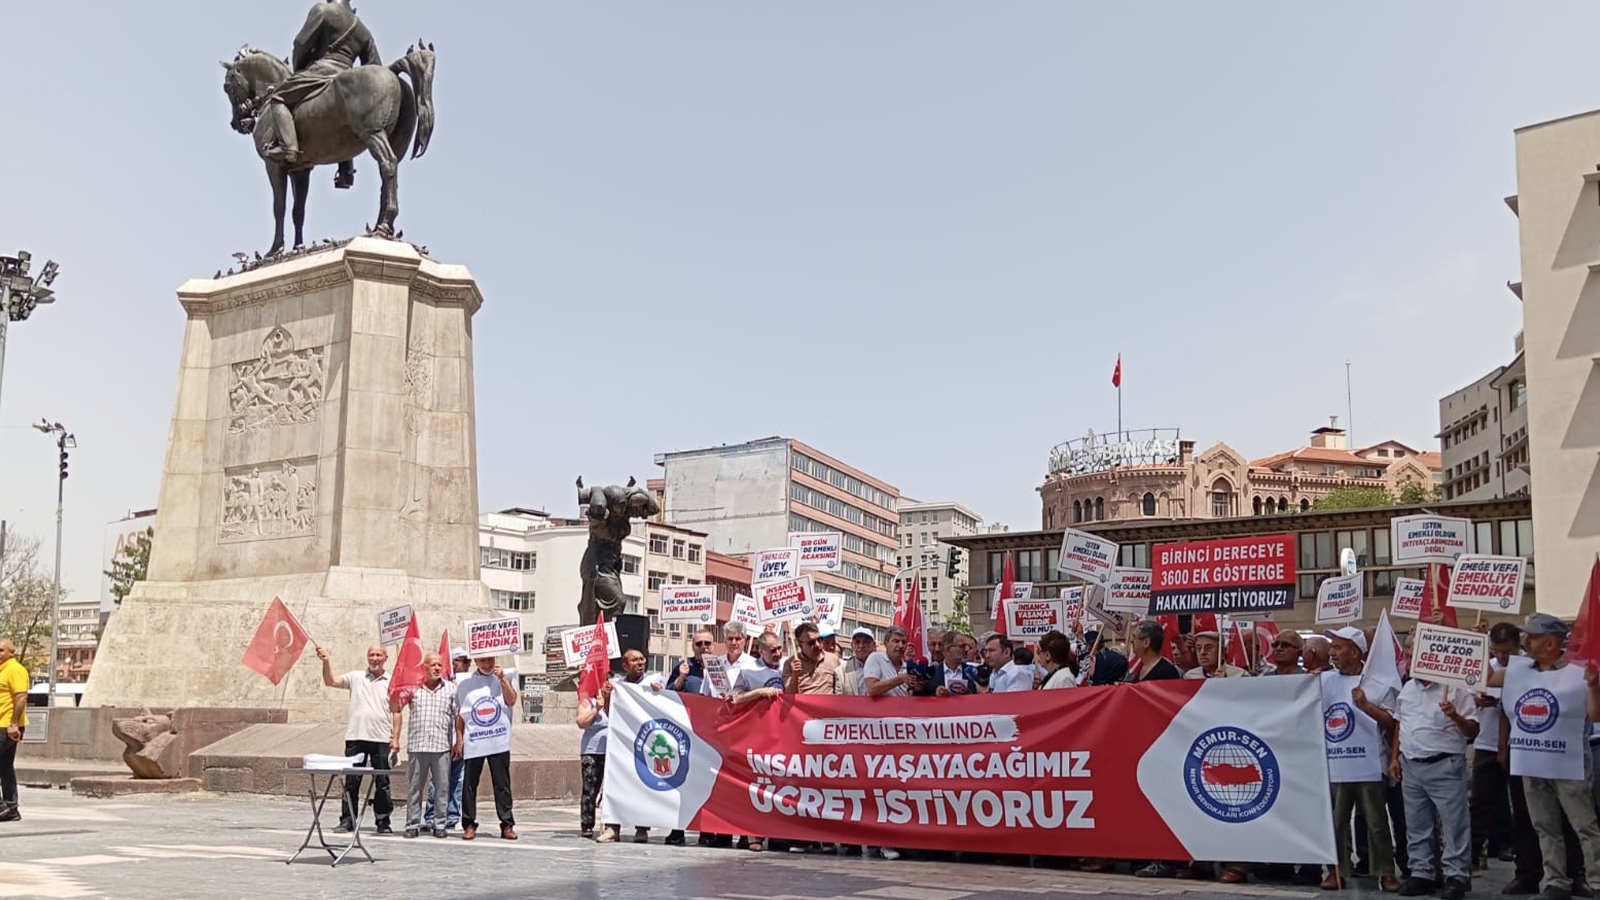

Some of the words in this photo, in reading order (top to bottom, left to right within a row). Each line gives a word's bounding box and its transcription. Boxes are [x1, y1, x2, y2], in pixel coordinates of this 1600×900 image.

[1161, 545, 1210, 566] BİRİNCİ
[1213, 543, 1285, 561] DERECEYE
[762, 561, 787, 572] ÜVEY
[1460, 561, 1491, 571] EMEĞE
[1493, 563, 1519, 572] VEFA
[1161, 569, 1189, 586] 3600
[1192, 568, 1210, 584] EK
[1213, 563, 1285, 583] GÖSTERGE
[1456, 572, 1517, 584] EMEKLİYE
[766, 581, 798, 594] İNSANCA
[1453, 583, 1513, 598] SENDİKA
[674, 591, 700, 599] EMEKLİ
[1156, 592, 1216, 611] HAKKIMIZI
[1218, 587, 1288, 608] İSTİYORUZ!
[1399, 597, 1421, 605] EME
[1018, 603, 1050, 611] İNSANCA
[471, 623, 497, 633] EMEĞE
[498, 620, 518, 629] VEFA
[1022, 626, 1036, 634] ÇOK
[471, 628, 518, 641] EMEKLİYE
[1423, 634, 1446, 642] HAYAT
[471, 636, 519, 650] SENDİKA
[1430, 643, 1450, 653] ÇOK
[1451, 645, 1473, 656] ZOR
[1420, 652, 1440, 663] GEL
[1443, 655, 1462, 666] BİR
[1464, 658, 1481, 668] DE
[1416, 661, 1460, 674] EMEKLİYE
[1461, 668, 1481, 677] SOR
[823, 719, 916, 740] EMEKLİLER
[921, 721, 997, 740] YILINDA
[1193, 730, 1268, 759] MEMUR-SEN
[1510, 737, 1566, 749] EMUR-SEN
[747, 748, 857, 779] İNSANCA
[864, 745, 1092, 784] YAŞAYACAĞIMIZ
[749, 777, 866, 822] ÜCRET
[873, 787, 1096, 829] İSTİYORUZ
